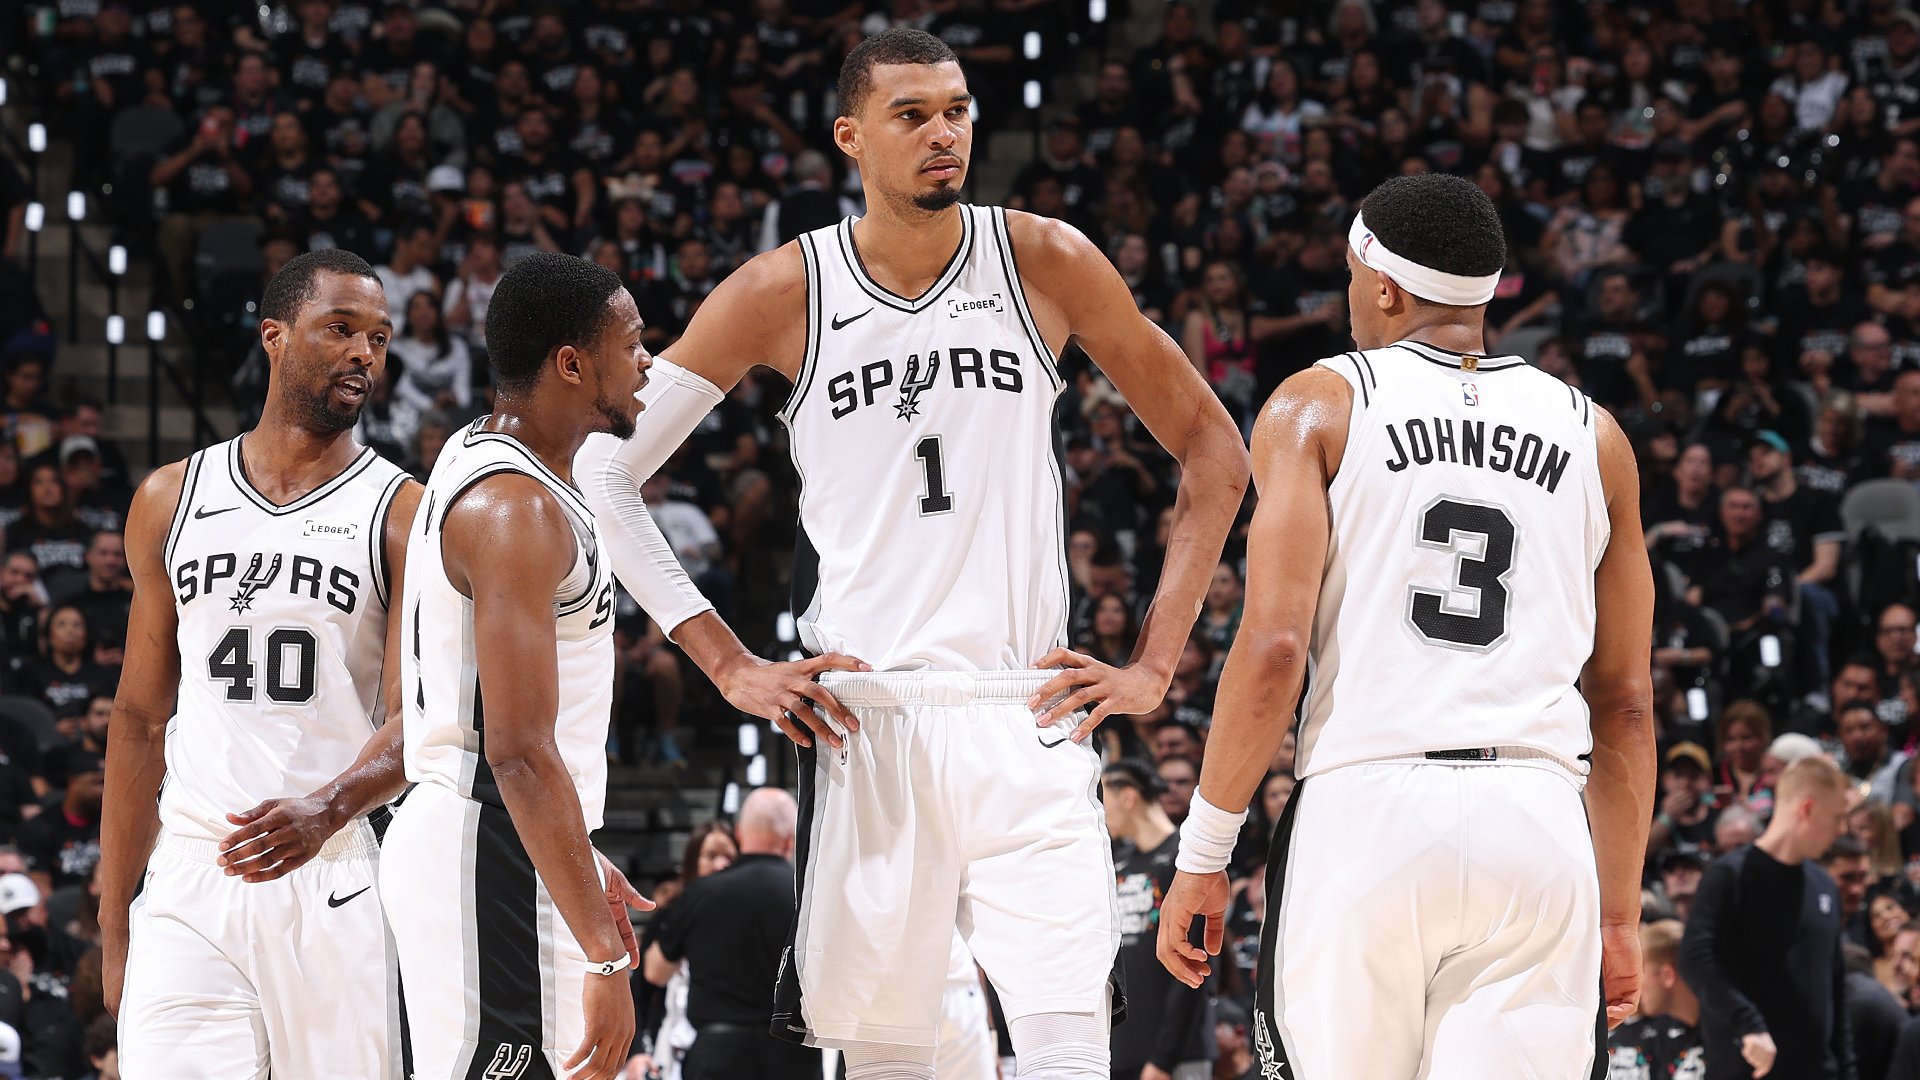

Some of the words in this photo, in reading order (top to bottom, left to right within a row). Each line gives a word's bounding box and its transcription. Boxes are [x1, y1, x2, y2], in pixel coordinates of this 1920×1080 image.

[955, 299, 996, 312] LEDGER
[828, 348, 1023, 423] SPURS
[913, 434, 956, 518] 1
[1386, 417, 1571, 494] JOHNSON
[311, 524, 350, 535] LEDGER
[176, 552, 360, 616] SPURS
[1404, 493, 1521, 654] 3
[206, 625, 320, 706] 40
